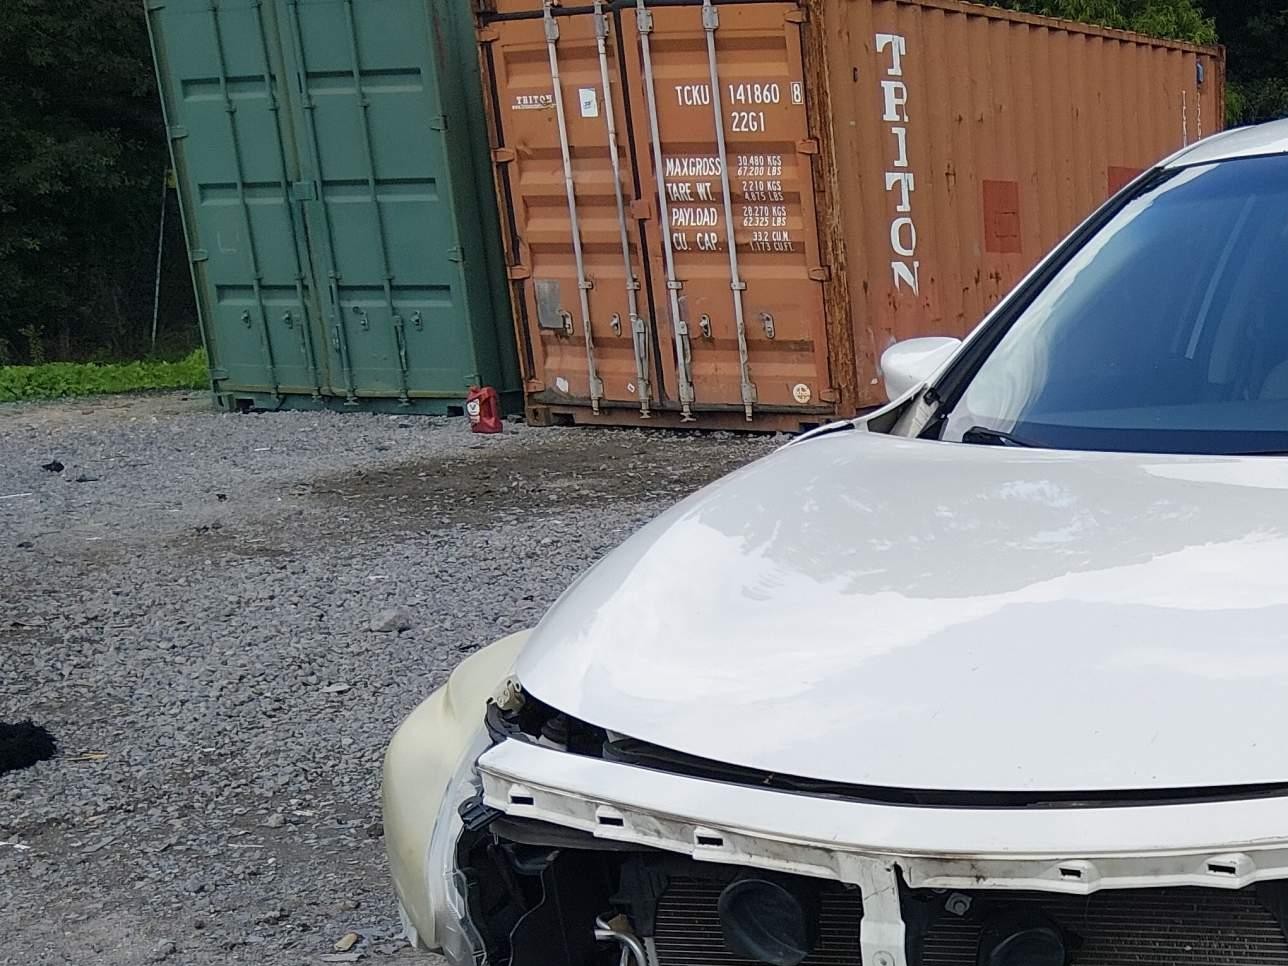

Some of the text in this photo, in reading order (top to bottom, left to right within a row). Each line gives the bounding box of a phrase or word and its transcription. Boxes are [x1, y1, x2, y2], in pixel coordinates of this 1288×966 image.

[675, 83, 802, 106] TCKU 141860 8
[731, 112, 765, 132] 22G1
[665, 157, 721, 177] MAXGROSS
[767, 155, 782, 167] KGS
[875, 33, 919, 297] TRITON
[767, 166, 782, 176] LBS
[666, 182, 716, 201] TARE WT.
[767, 181, 782, 191] KGS
[768, 191, 784, 201] LBS
[671, 207, 718, 226] PAYLOAD
[772, 206, 787, 217] KGS
[772, 217, 787, 227] LBS
[673, 232, 722, 251] CU. CAP.
[752, 231, 769, 242] 33.2
